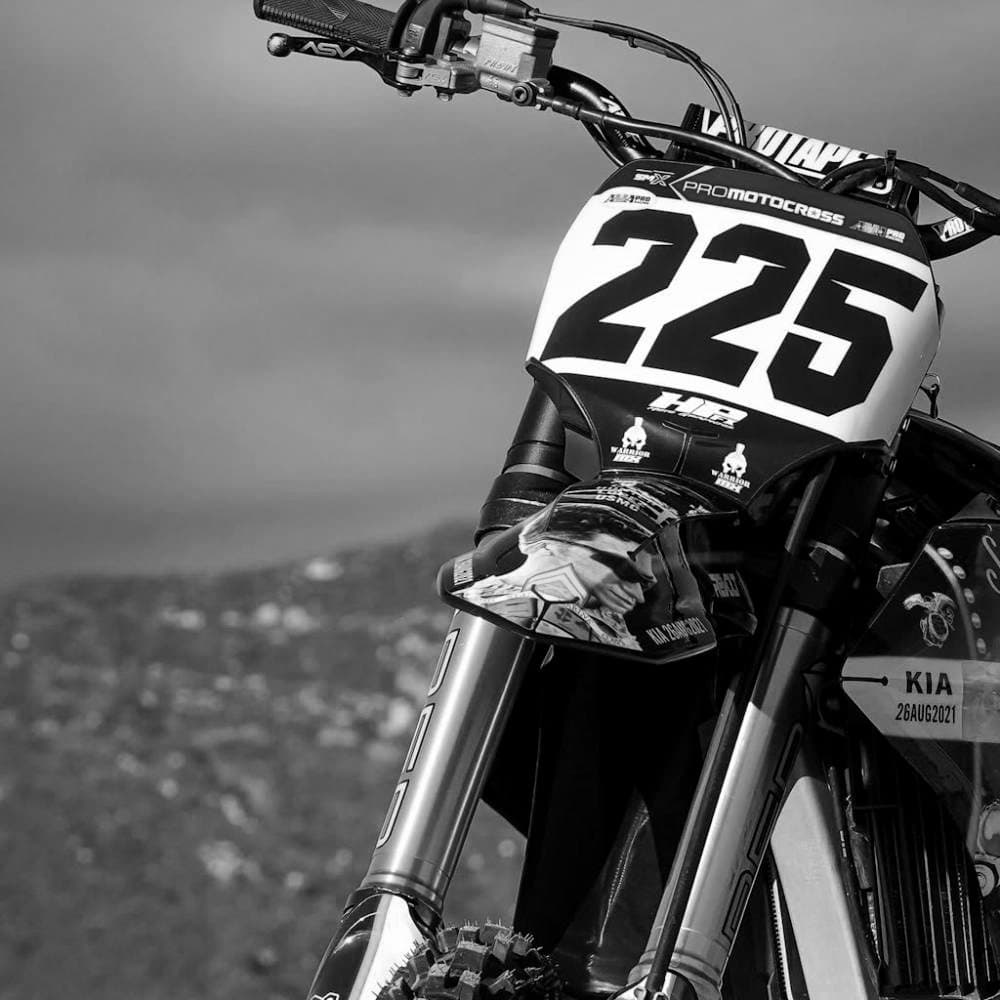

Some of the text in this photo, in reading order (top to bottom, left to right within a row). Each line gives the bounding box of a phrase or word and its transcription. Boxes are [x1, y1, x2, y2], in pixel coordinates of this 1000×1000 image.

[299, 41, 355, 58] ASV
[540, 208, 928, 417] 225
[906, 671, 953, 696] KIA
[895, 703, 957, 724] 26AUG2021
